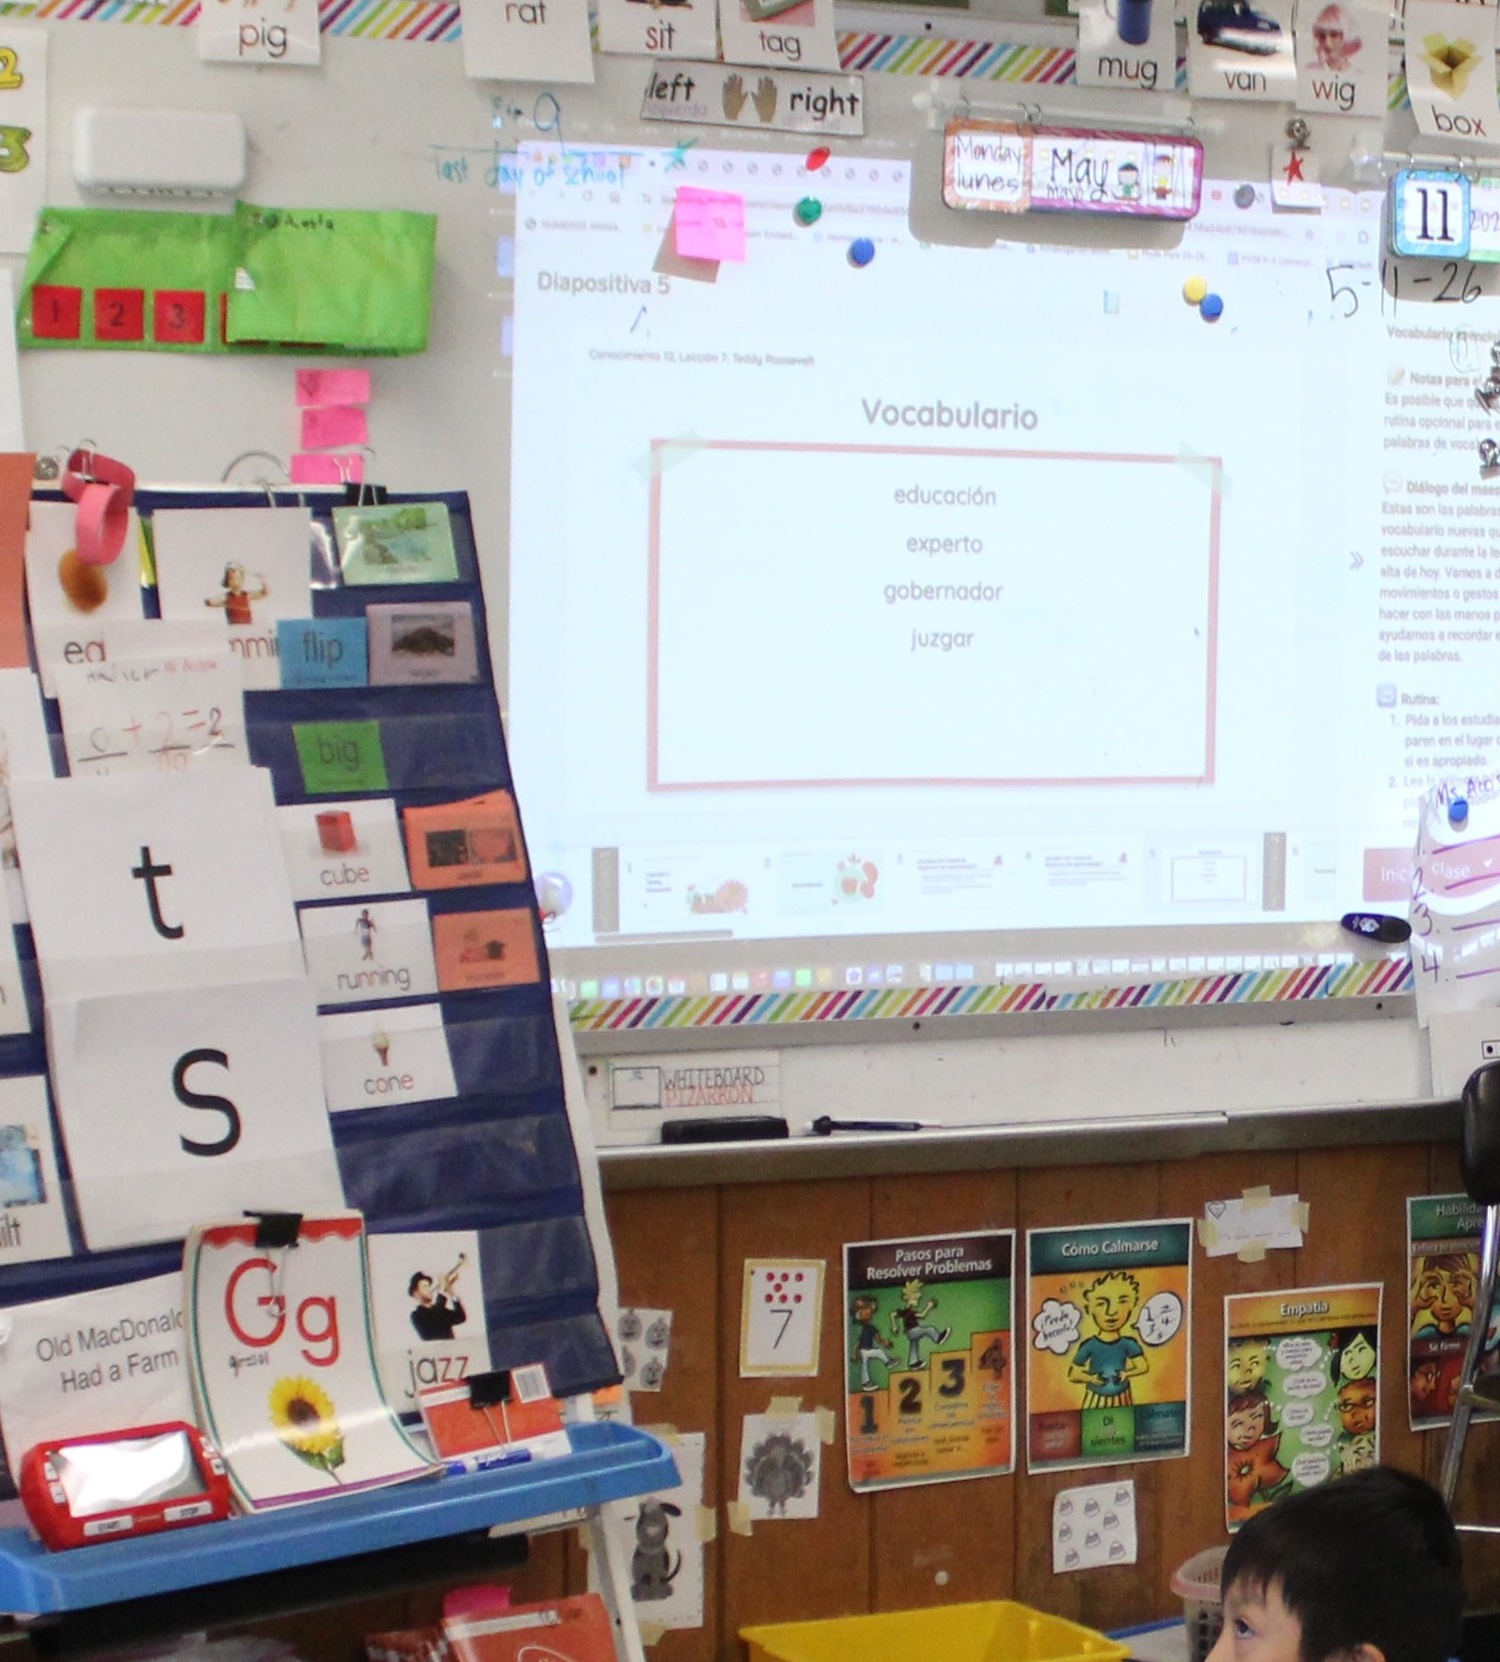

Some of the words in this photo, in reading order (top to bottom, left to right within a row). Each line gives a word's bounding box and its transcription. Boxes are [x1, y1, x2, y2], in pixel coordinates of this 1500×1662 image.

[239, 21, 287, 57] pig
[646, 22, 676, 52] sit
[758, 30, 801, 60] tag
[1098, 54, 1157, 90] mug
[1225, 70, 1266, 93] van
[646, 72, 695, 101] left
[789, 81, 859, 120] right
[1311, 78, 1355, 110] wig
[1433, 107, 1486, 138] box
[955, 134, 1023, 178] Monday
[956, 169, 1018, 194] lunes
[1050, 150, 1112, 200] May
[1415, 188, 1451, 242] 11
[537, 271, 651, 296] Diapositiva
[657, 273, 670, 294] 5
[861, 398, 1038, 430] Vocabulario
[894, 485, 997, 506] educación
[906, 534, 983, 557] experto
[883, 580, 1004, 603] gobernador
[303, 631, 344, 669] flip
[909, 628, 974, 651] juzgar
[318, 736, 360, 771] big
[321, 863, 370, 886] cube
[131, 845, 185, 940] t
[337, 966, 411, 992] running
[364, 1073, 414, 1094] cone
[895, 1248, 932, 1263] Pasos
[934, 1246, 964, 1262] para
[1061, 1238, 1099, 1257] Cómo
[1101, 1236, 1159, 1256] Calmarse
[866, 1263, 922, 1280] Resolver
[925, 1259, 992, 1275] Problemas
[224, 1257, 340, 1368] Gg
[770, 1309, 793, 1350] 7
[59, 1365, 105, 1394] Had
[107, 1367, 121, 1382] a
[126, 1347, 179, 1378] Farm
[404, 1354, 470, 1397] jazz
[940, 1359, 965, 1396] 3
[899, 1379, 923, 1412] 2
[860, 1395, 878, 1434] 1
